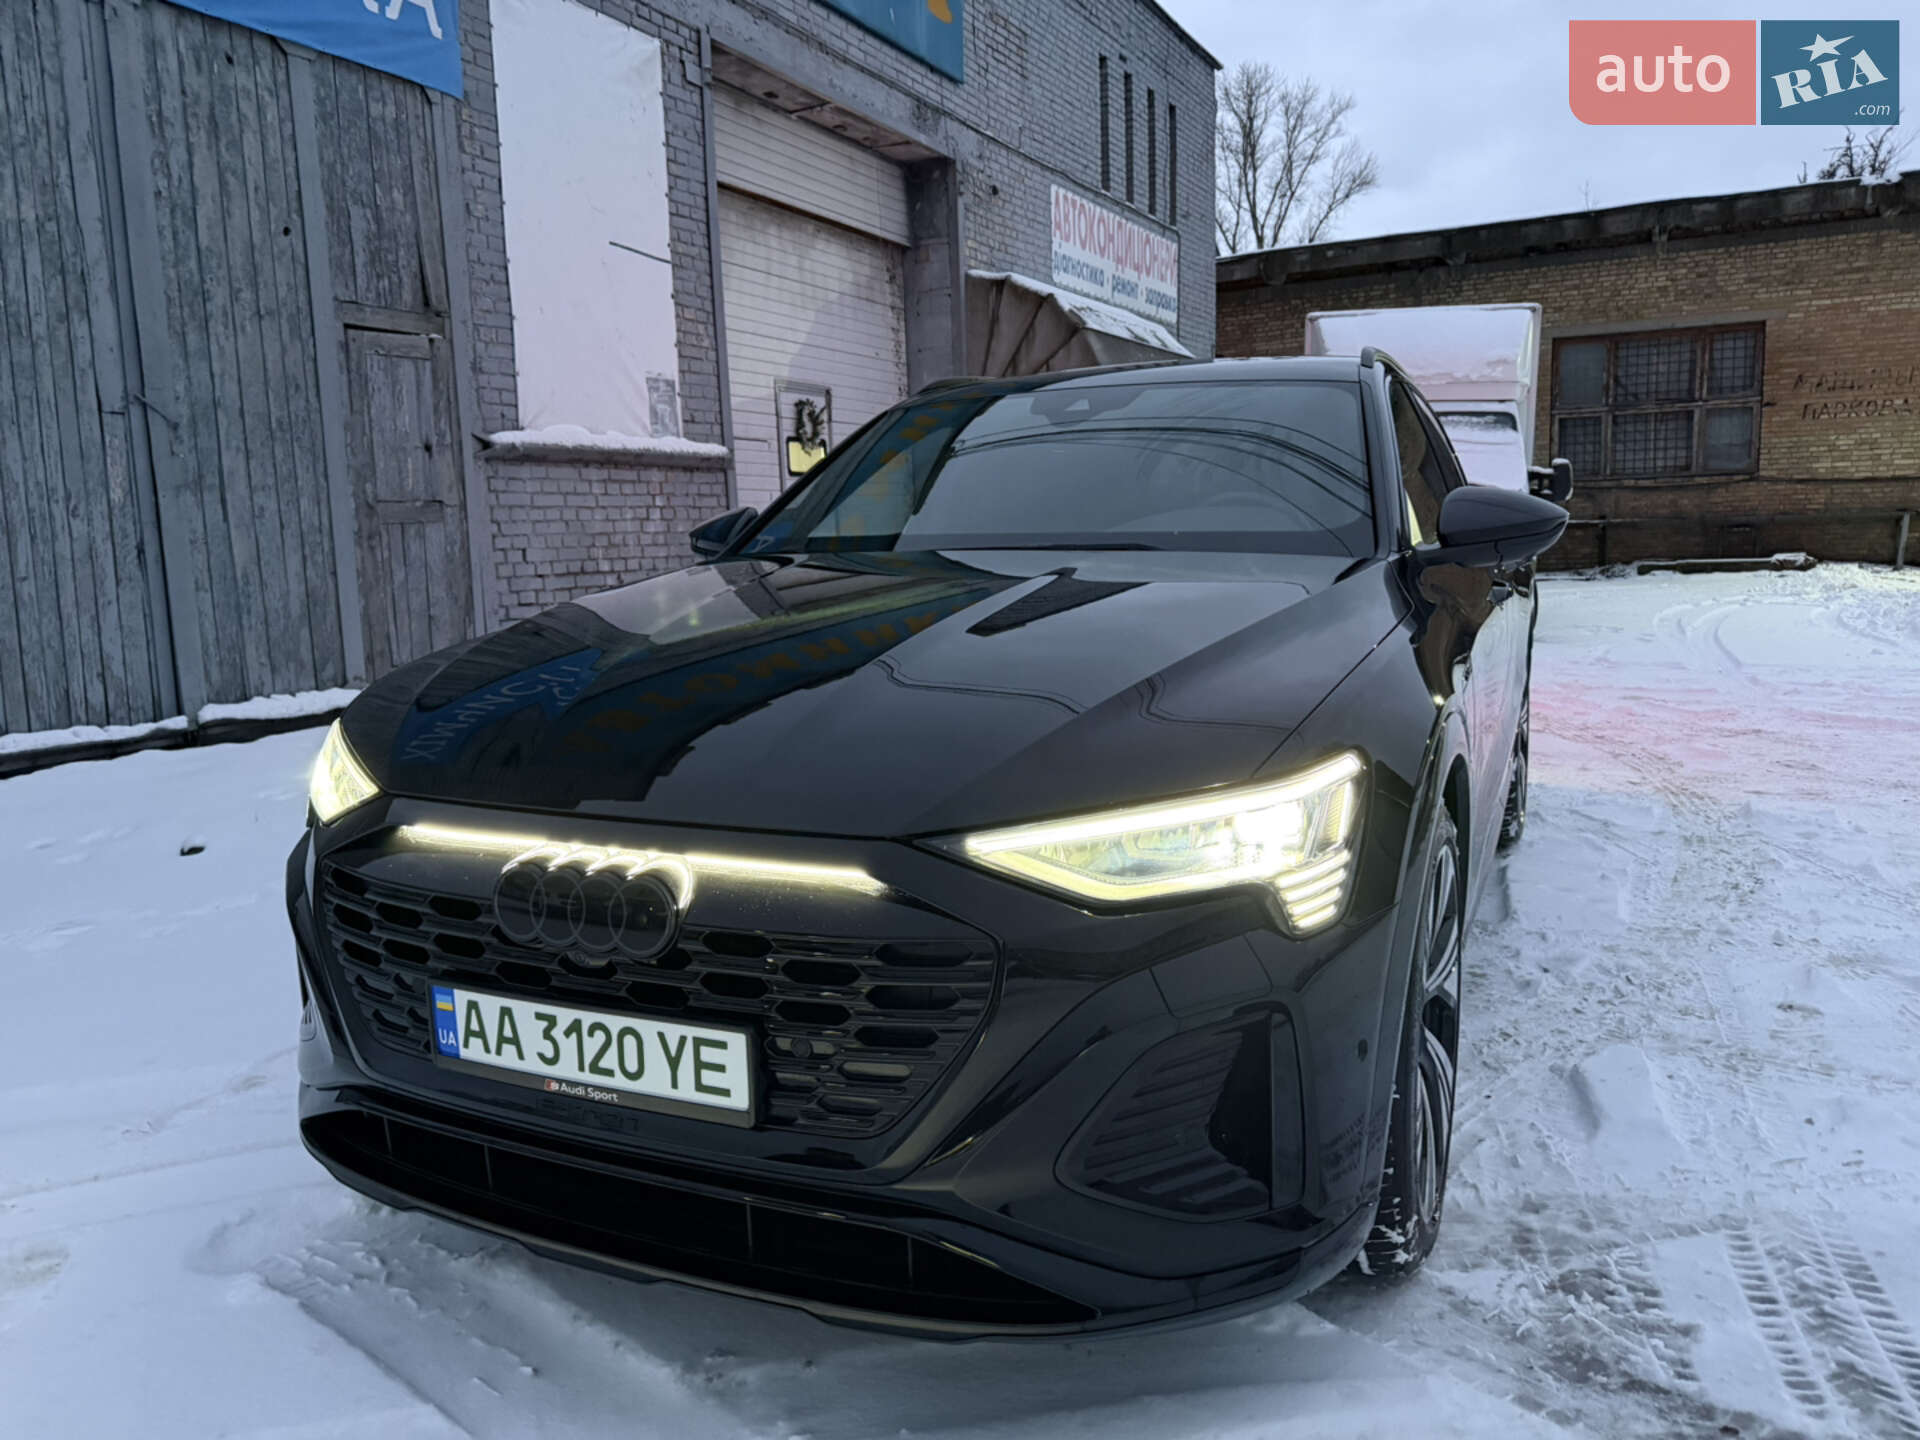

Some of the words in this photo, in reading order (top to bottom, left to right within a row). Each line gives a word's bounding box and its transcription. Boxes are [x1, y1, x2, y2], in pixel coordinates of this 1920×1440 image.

[437, 1027, 457, 1047] UA
[462, 999, 525, 1061] AA
[533, 1011, 645, 1082] 3120
[656, 1031, 732, 1098] YE
[560, 1082, 585, 1096] Audi
[587, 1087, 618, 1102] Sport
